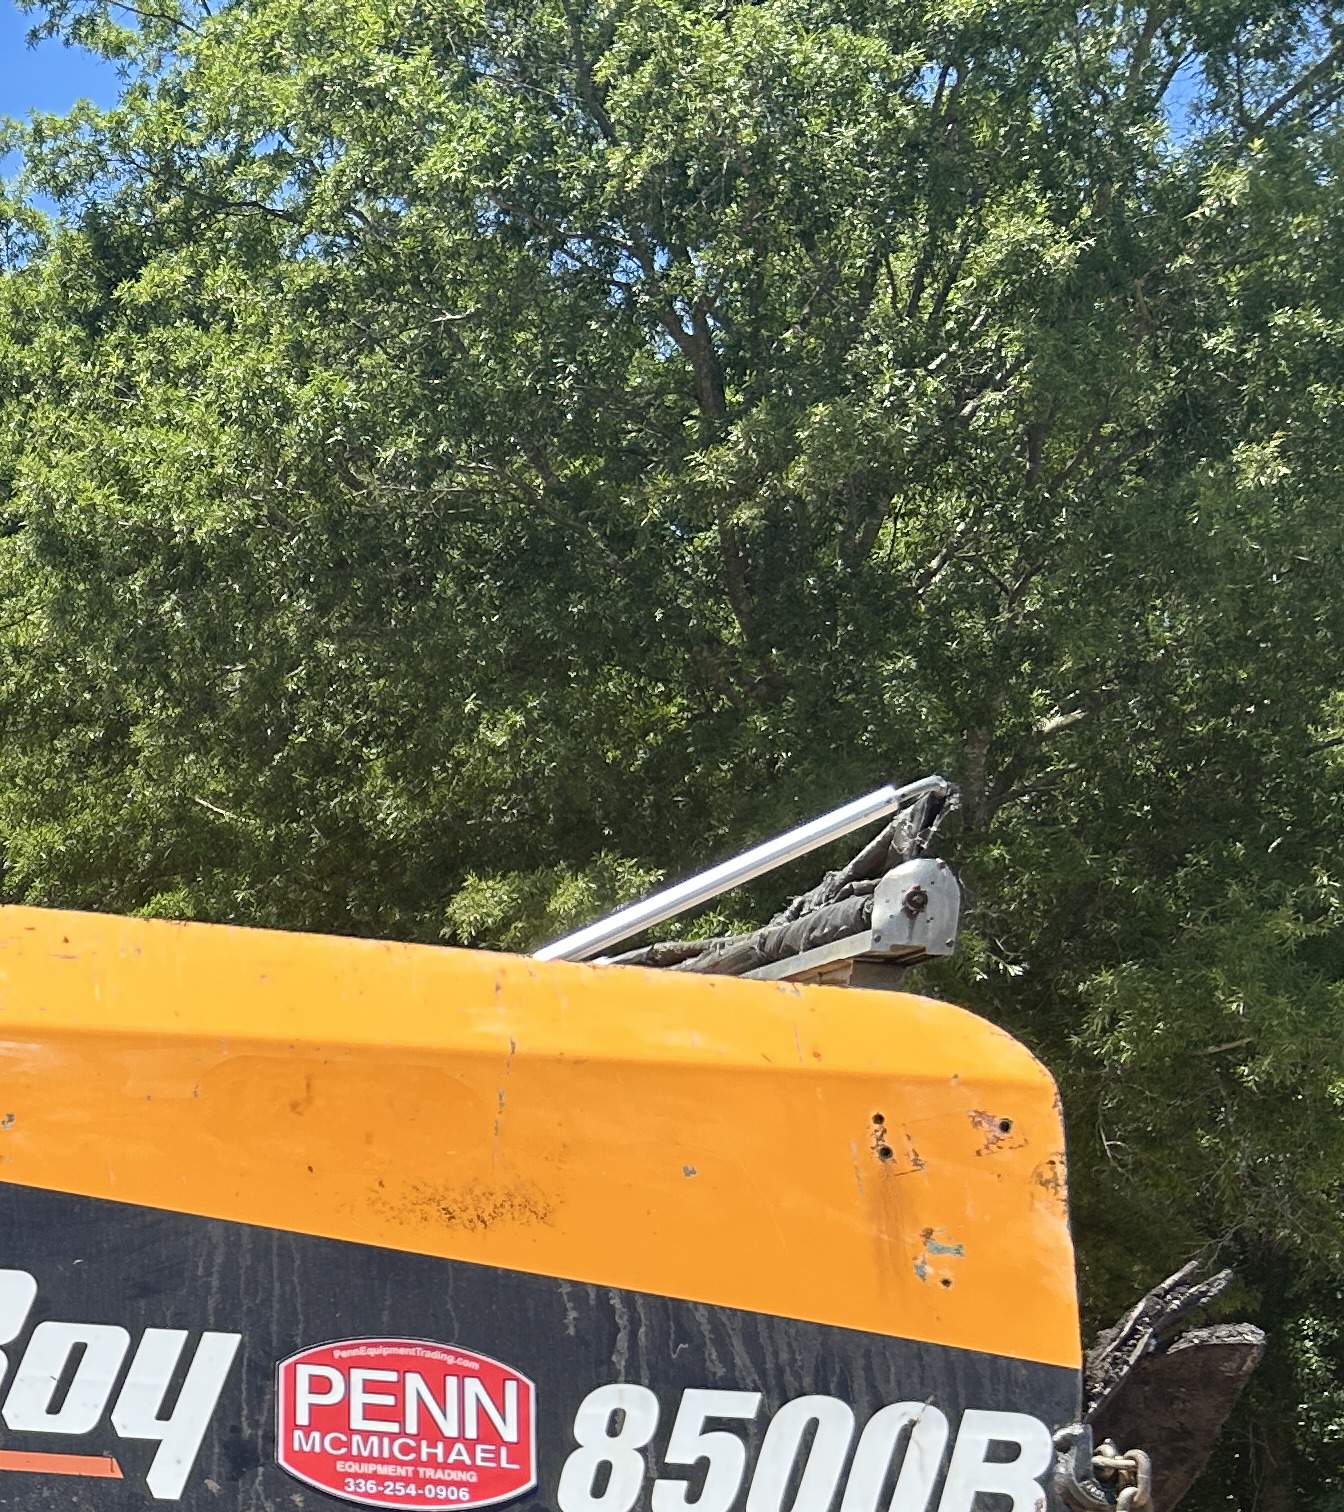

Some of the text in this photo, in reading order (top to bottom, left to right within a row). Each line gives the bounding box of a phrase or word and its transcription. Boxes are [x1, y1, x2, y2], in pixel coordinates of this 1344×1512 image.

[333, 1345, 480, 1370] PennEquipmentTrading.com
[294, 1363, 518, 1443] PENN
[292, 1429, 521, 1469] MCMICHAEL
[336, 1460, 478, 1483] EQUIPMENT TRADING
[344, 1478, 470, 1501] 336-254-0906
